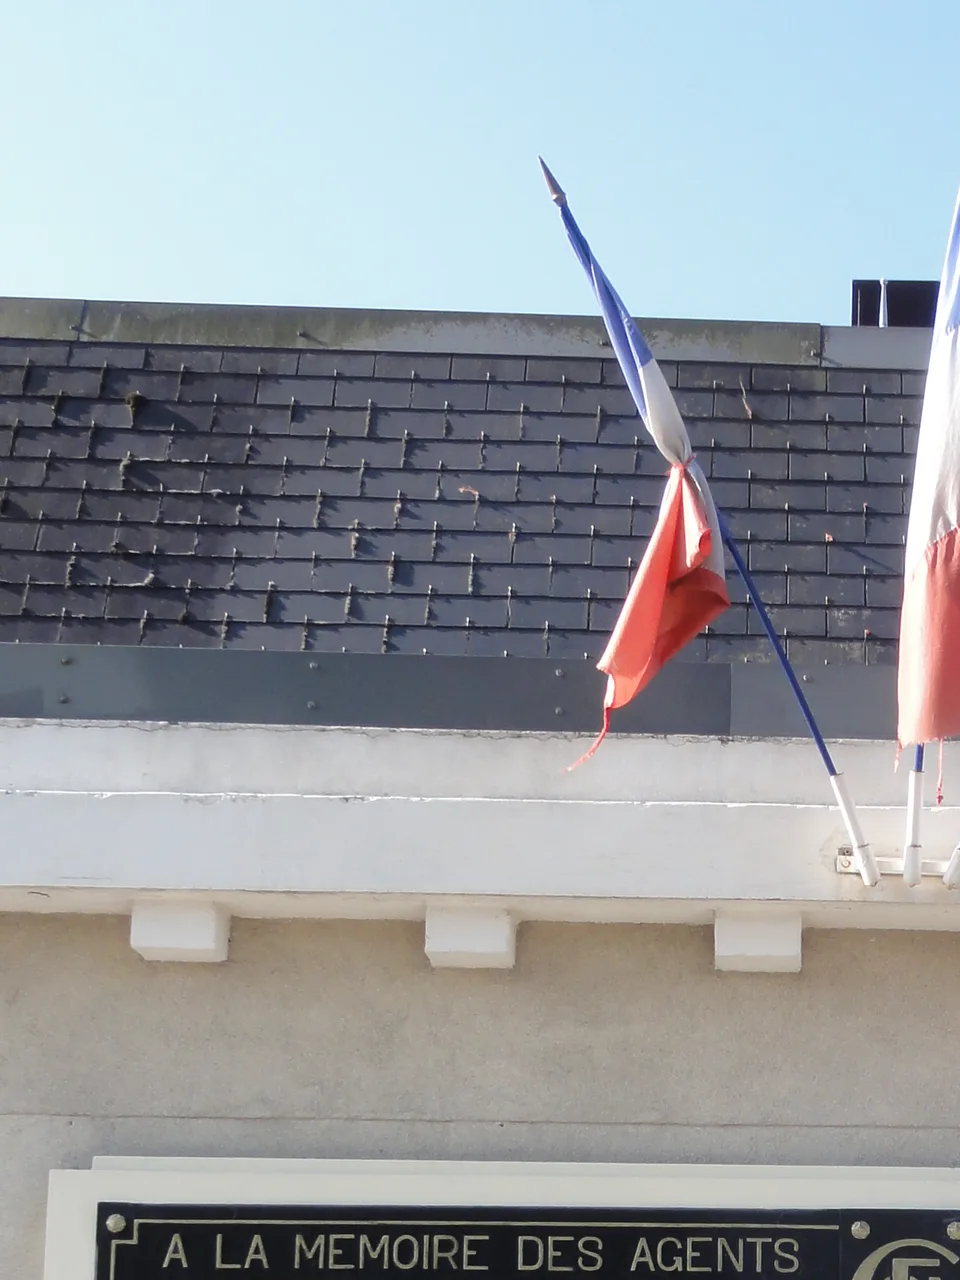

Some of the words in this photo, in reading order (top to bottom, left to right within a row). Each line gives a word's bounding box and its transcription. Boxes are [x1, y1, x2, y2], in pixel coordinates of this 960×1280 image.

[163, 1234, 188, 1267] A
[216, 1235, 268, 1268] LA
[295, 1234, 489, 1270] MEMOIRE
[518, 1236, 602, 1271] DES
[631, 1237, 799, 1272] AGENTS
